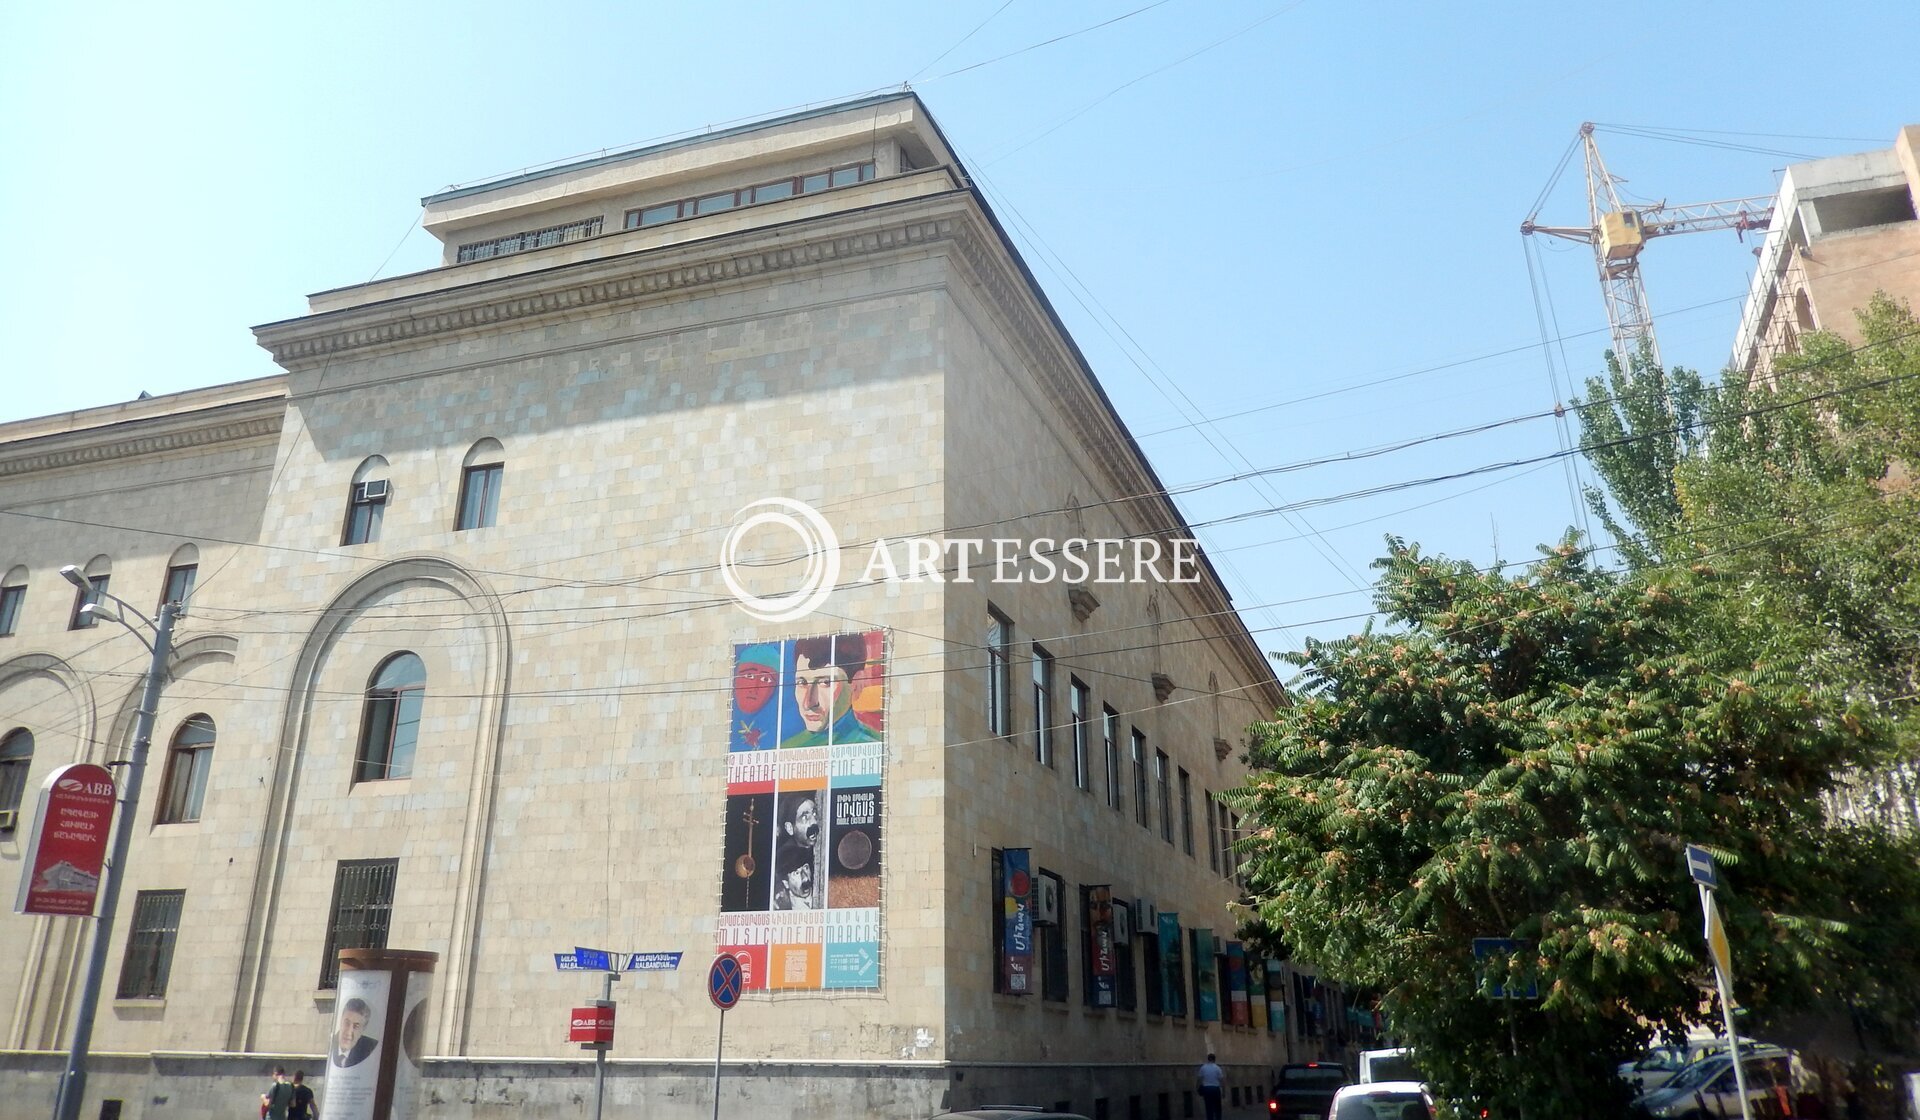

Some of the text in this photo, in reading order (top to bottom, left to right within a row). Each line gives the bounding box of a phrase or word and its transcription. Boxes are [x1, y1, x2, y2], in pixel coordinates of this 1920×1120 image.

[728, 764, 776, 783] THEATRE
[778, 761, 829, 780] LITERATURE
[831, 756, 882, 777] FINE ART
[82, 782, 113, 796] ABB
[836, 800, 875, 818] ԱՐՎԵՍՏ
[719, 926, 770, 945] MUSIC
[771, 924, 824, 945] CINEMA
[826, 924, 879, 943] MARCOS
